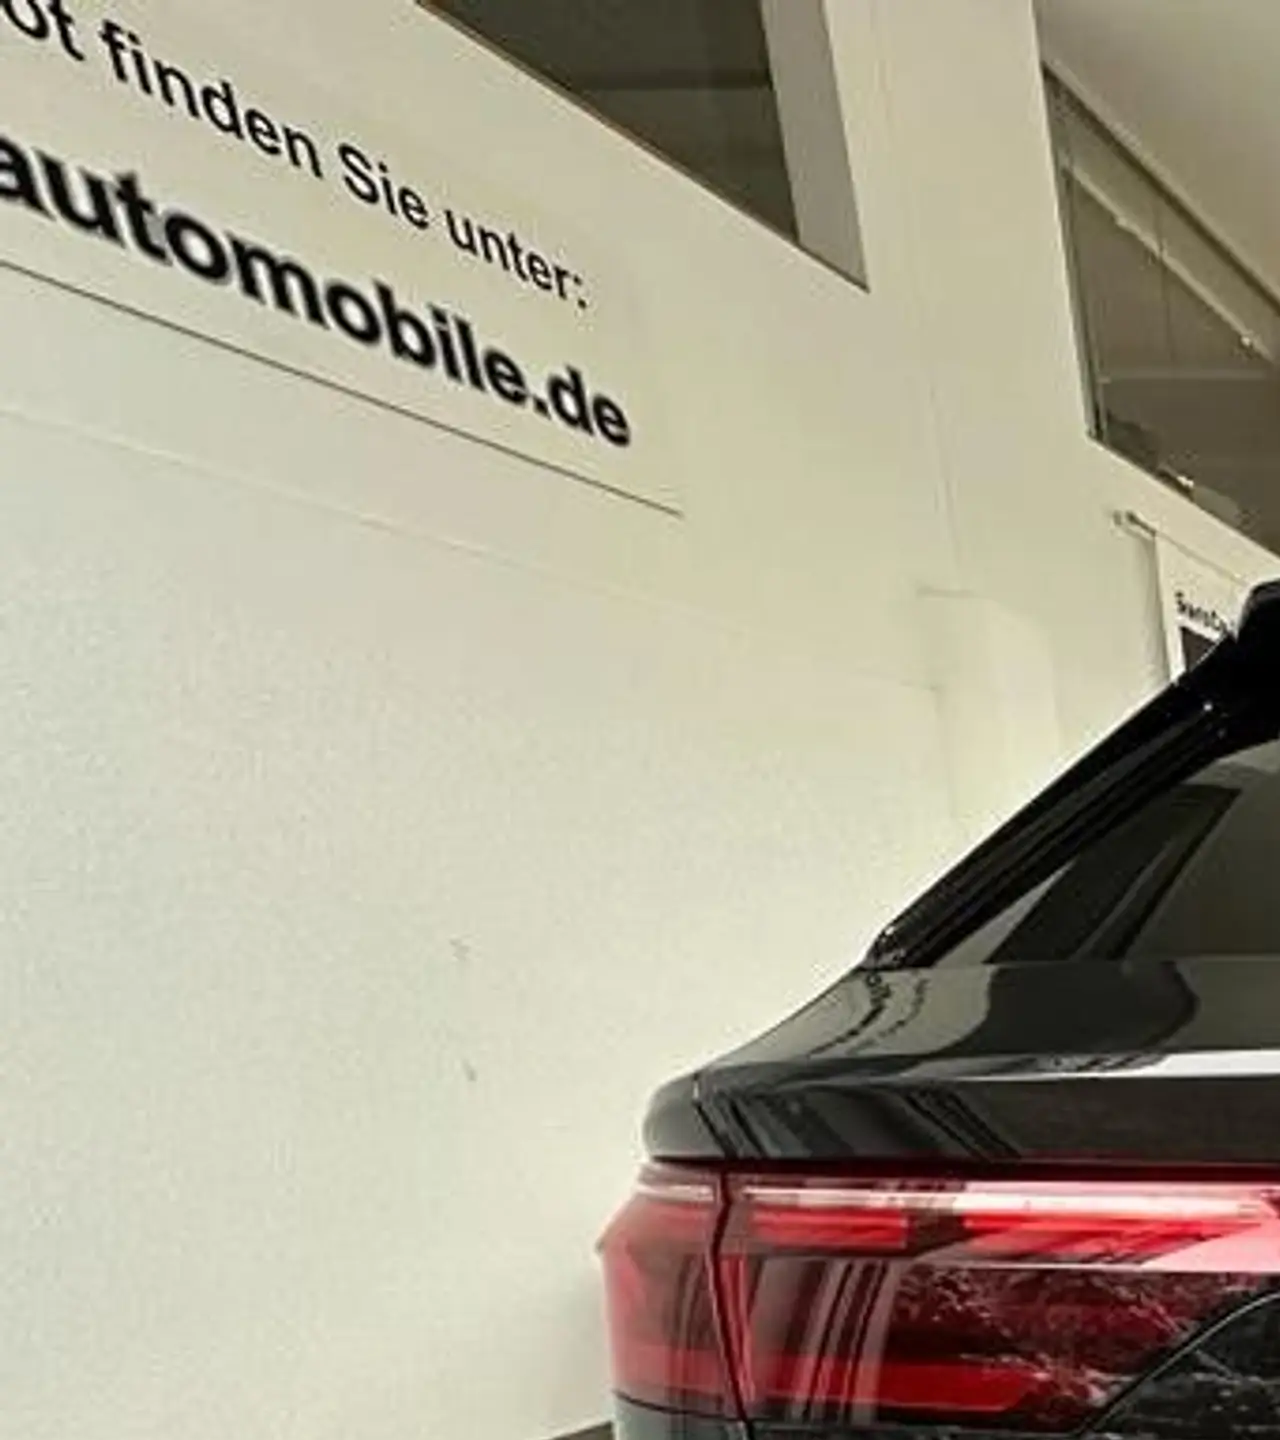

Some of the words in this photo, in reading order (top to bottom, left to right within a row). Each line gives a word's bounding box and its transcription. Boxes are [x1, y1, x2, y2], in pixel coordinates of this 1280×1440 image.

[0, 136, 630, 447] automobile.de
[99, 19, 324, 179] finden
[339, 143, 429, 230] Sie
[444, 208, 588, 309] unter:
